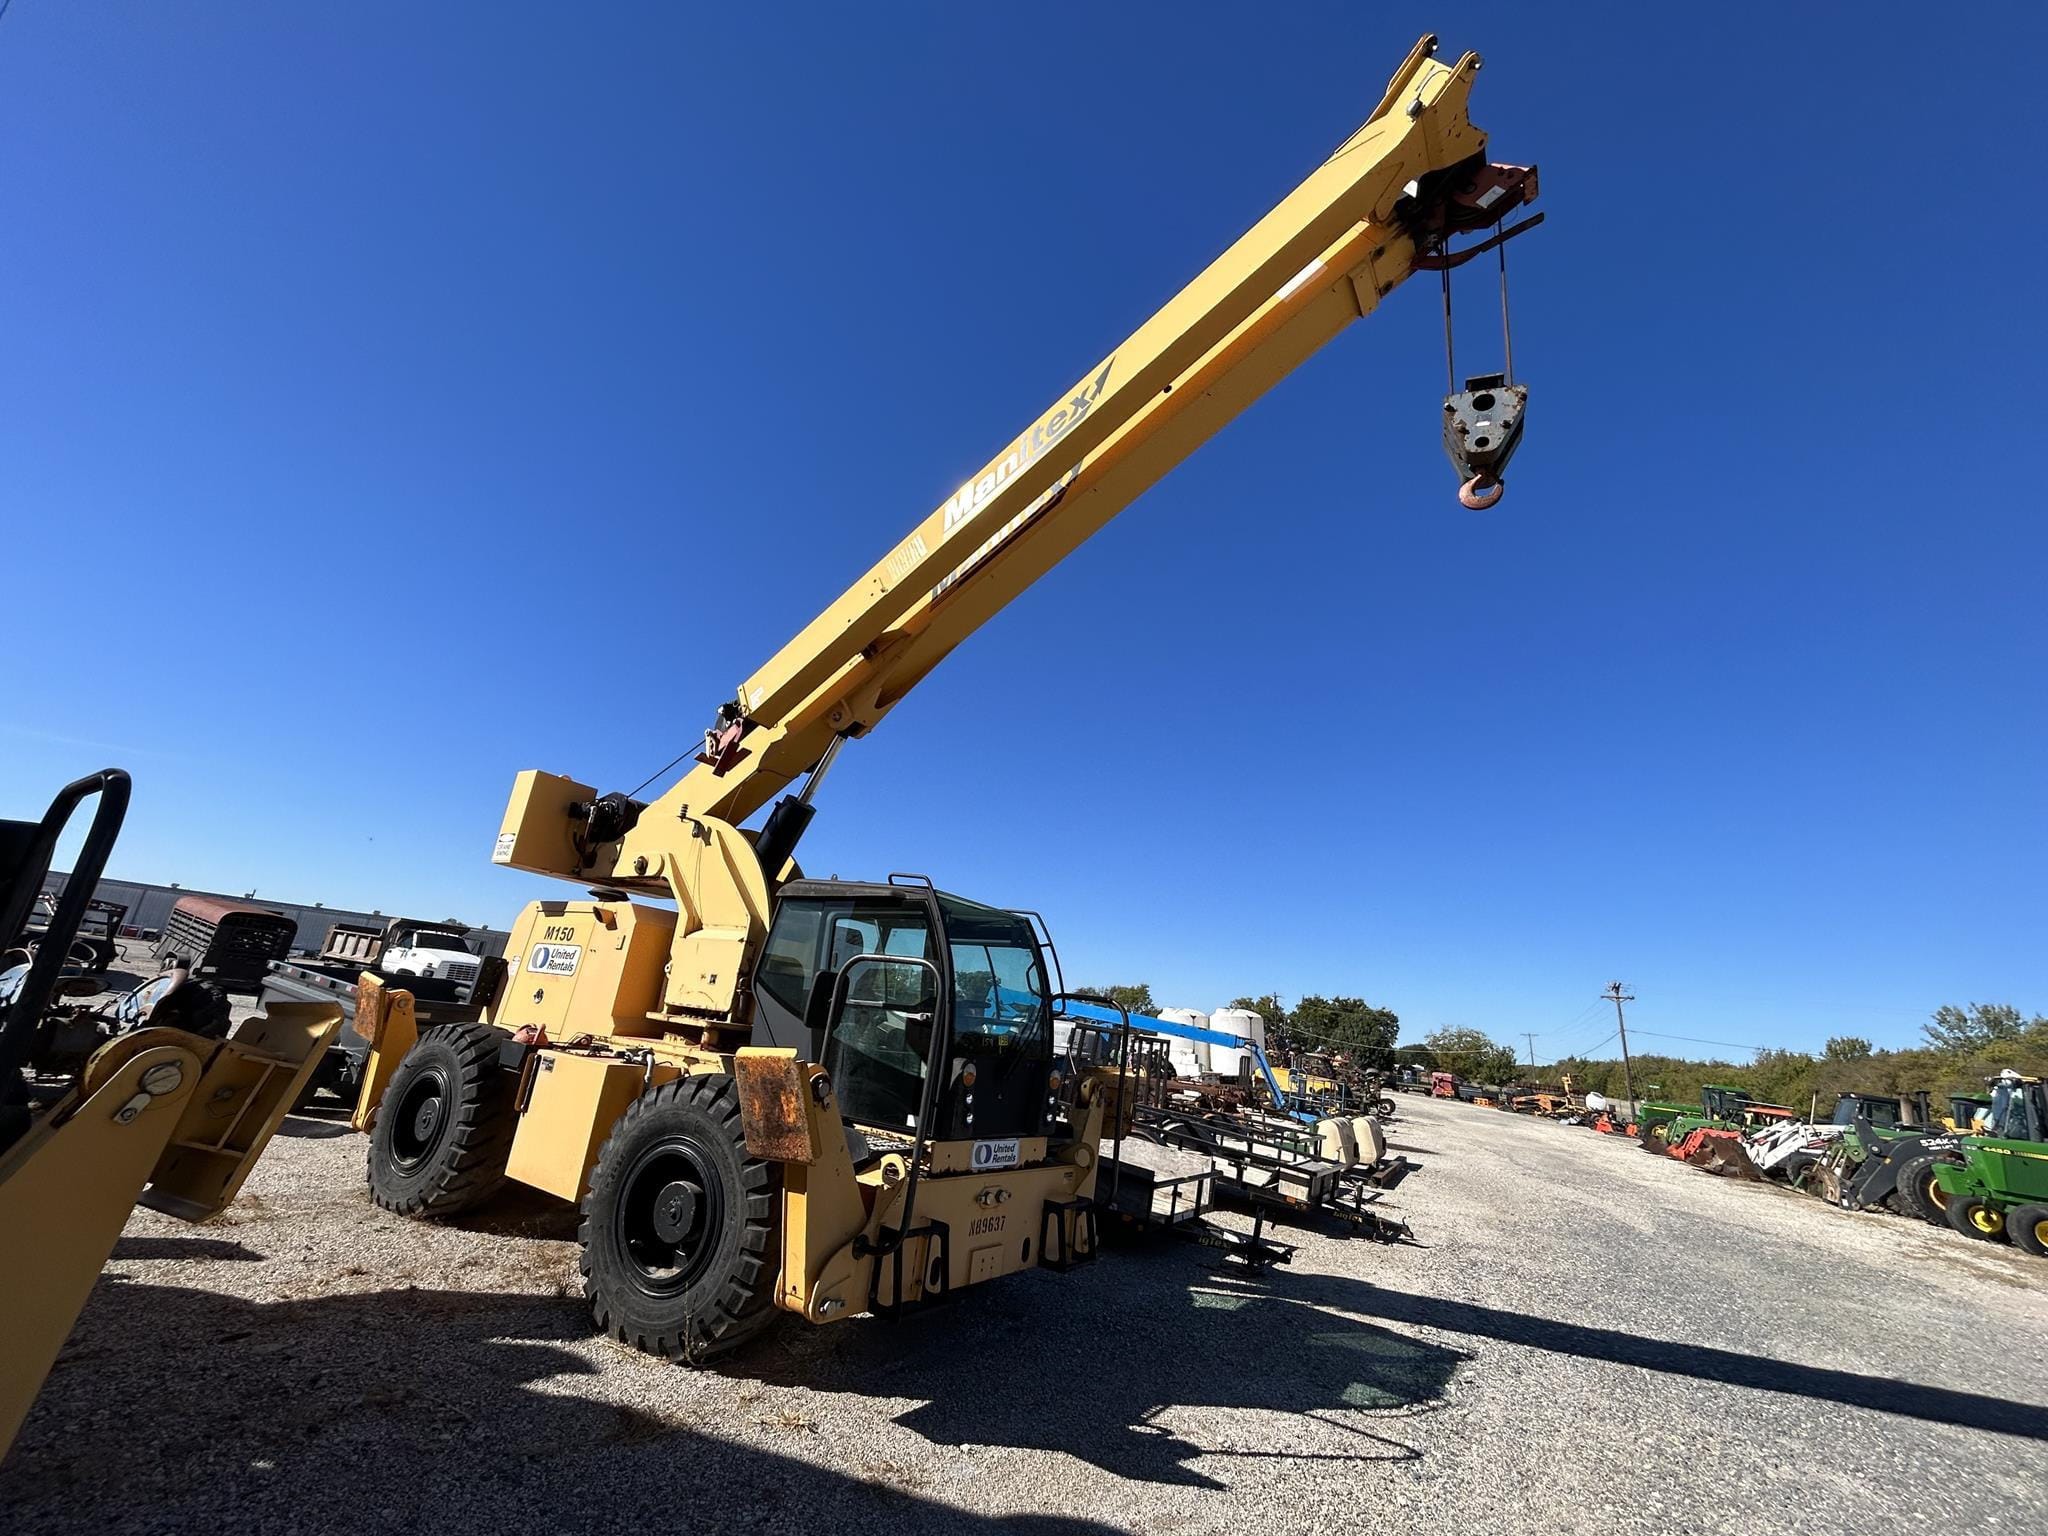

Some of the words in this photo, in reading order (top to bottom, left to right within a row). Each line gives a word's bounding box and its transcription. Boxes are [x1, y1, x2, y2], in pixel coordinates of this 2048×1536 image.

[943, 382, 1094, 533] Manitex
[543, 926, 575, 941] M150
[550, 948, 577, 960] United
[546, 960, 574, 972] Rentals
[993, 1142, 1018, 1154] United
[991, 1153, 1017, 1164] Rentals
[968, 1215, 1006, 1237] N89637
